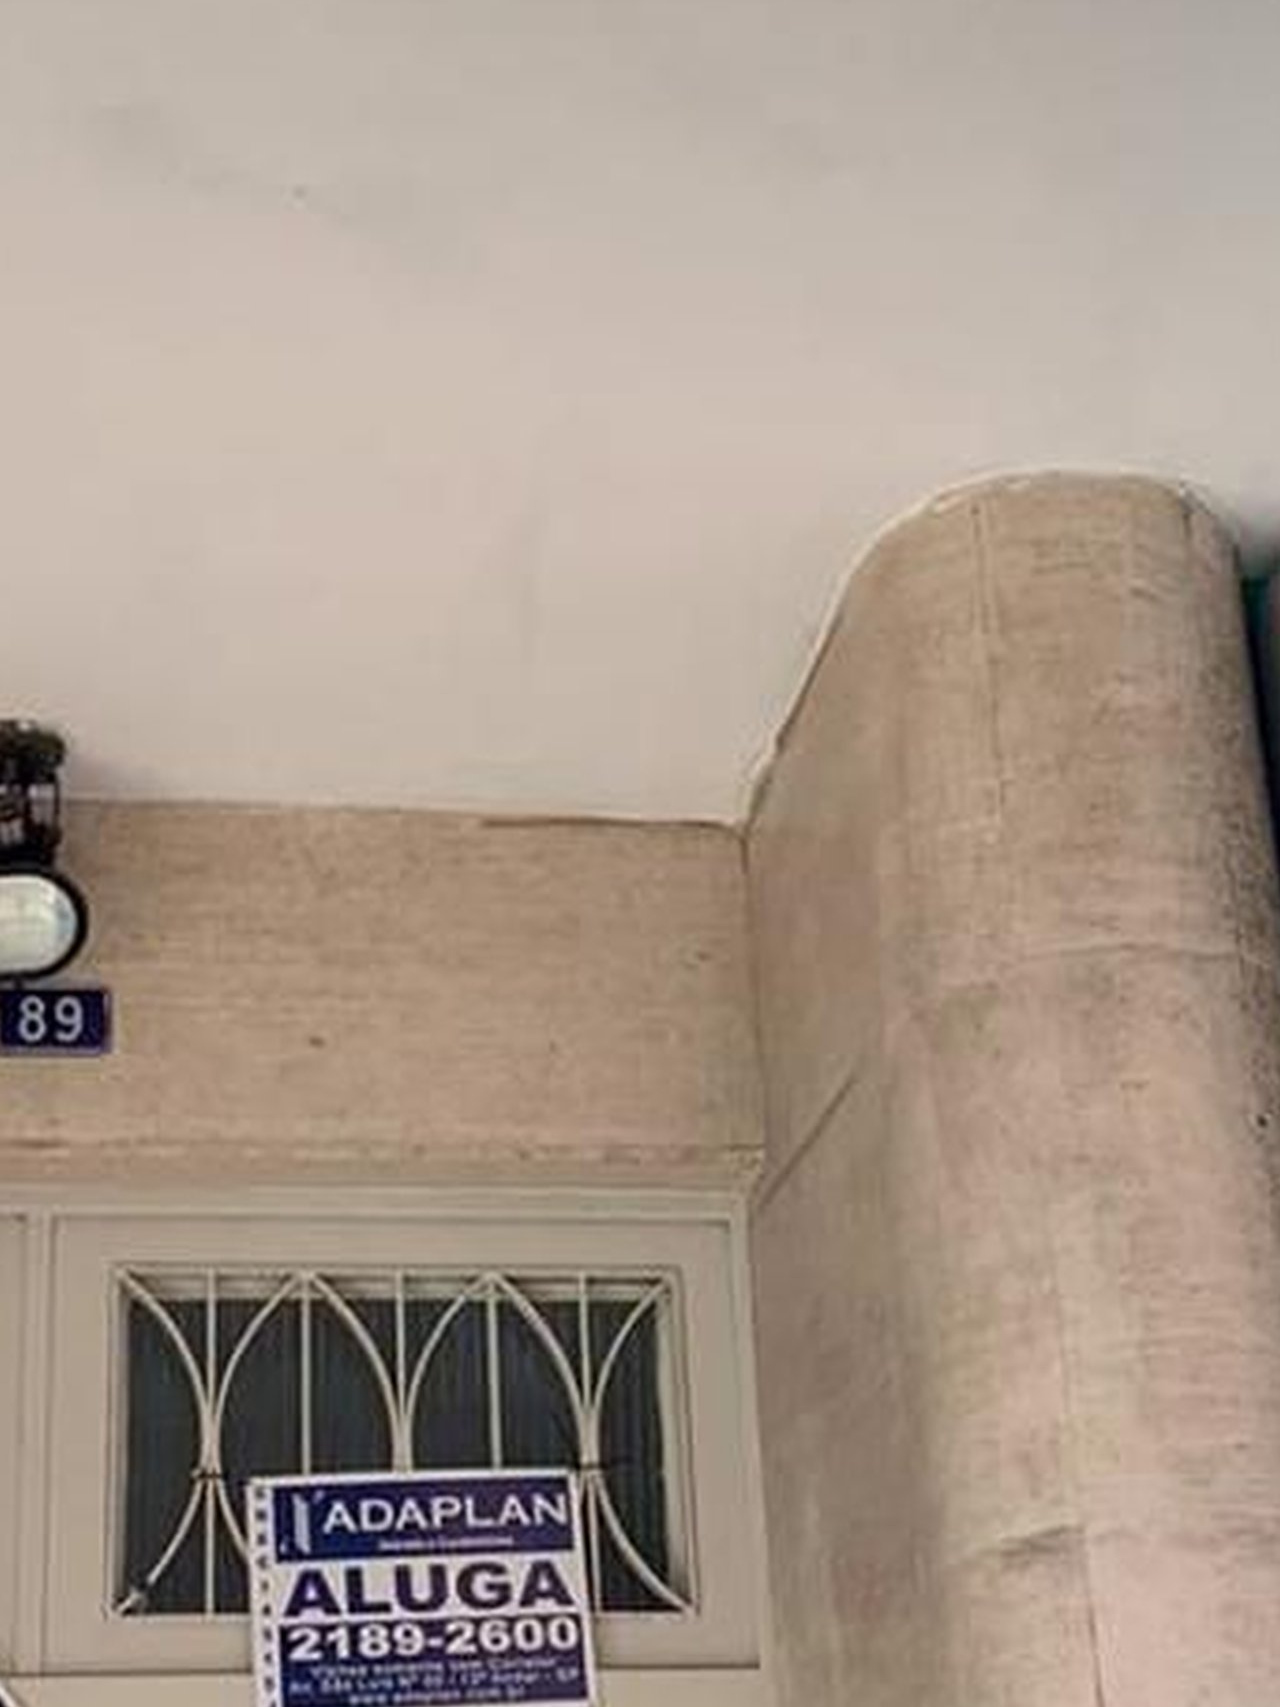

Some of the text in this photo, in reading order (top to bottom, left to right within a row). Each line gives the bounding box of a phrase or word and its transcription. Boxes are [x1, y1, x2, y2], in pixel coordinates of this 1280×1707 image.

[19, 995, 83, 1042] 89
[323, 1493, 568, 1534] ADAPLAN
[283, 1559, 576, 1617] ALUGA
[288, 1616, 578, 1661] 2189-2600
